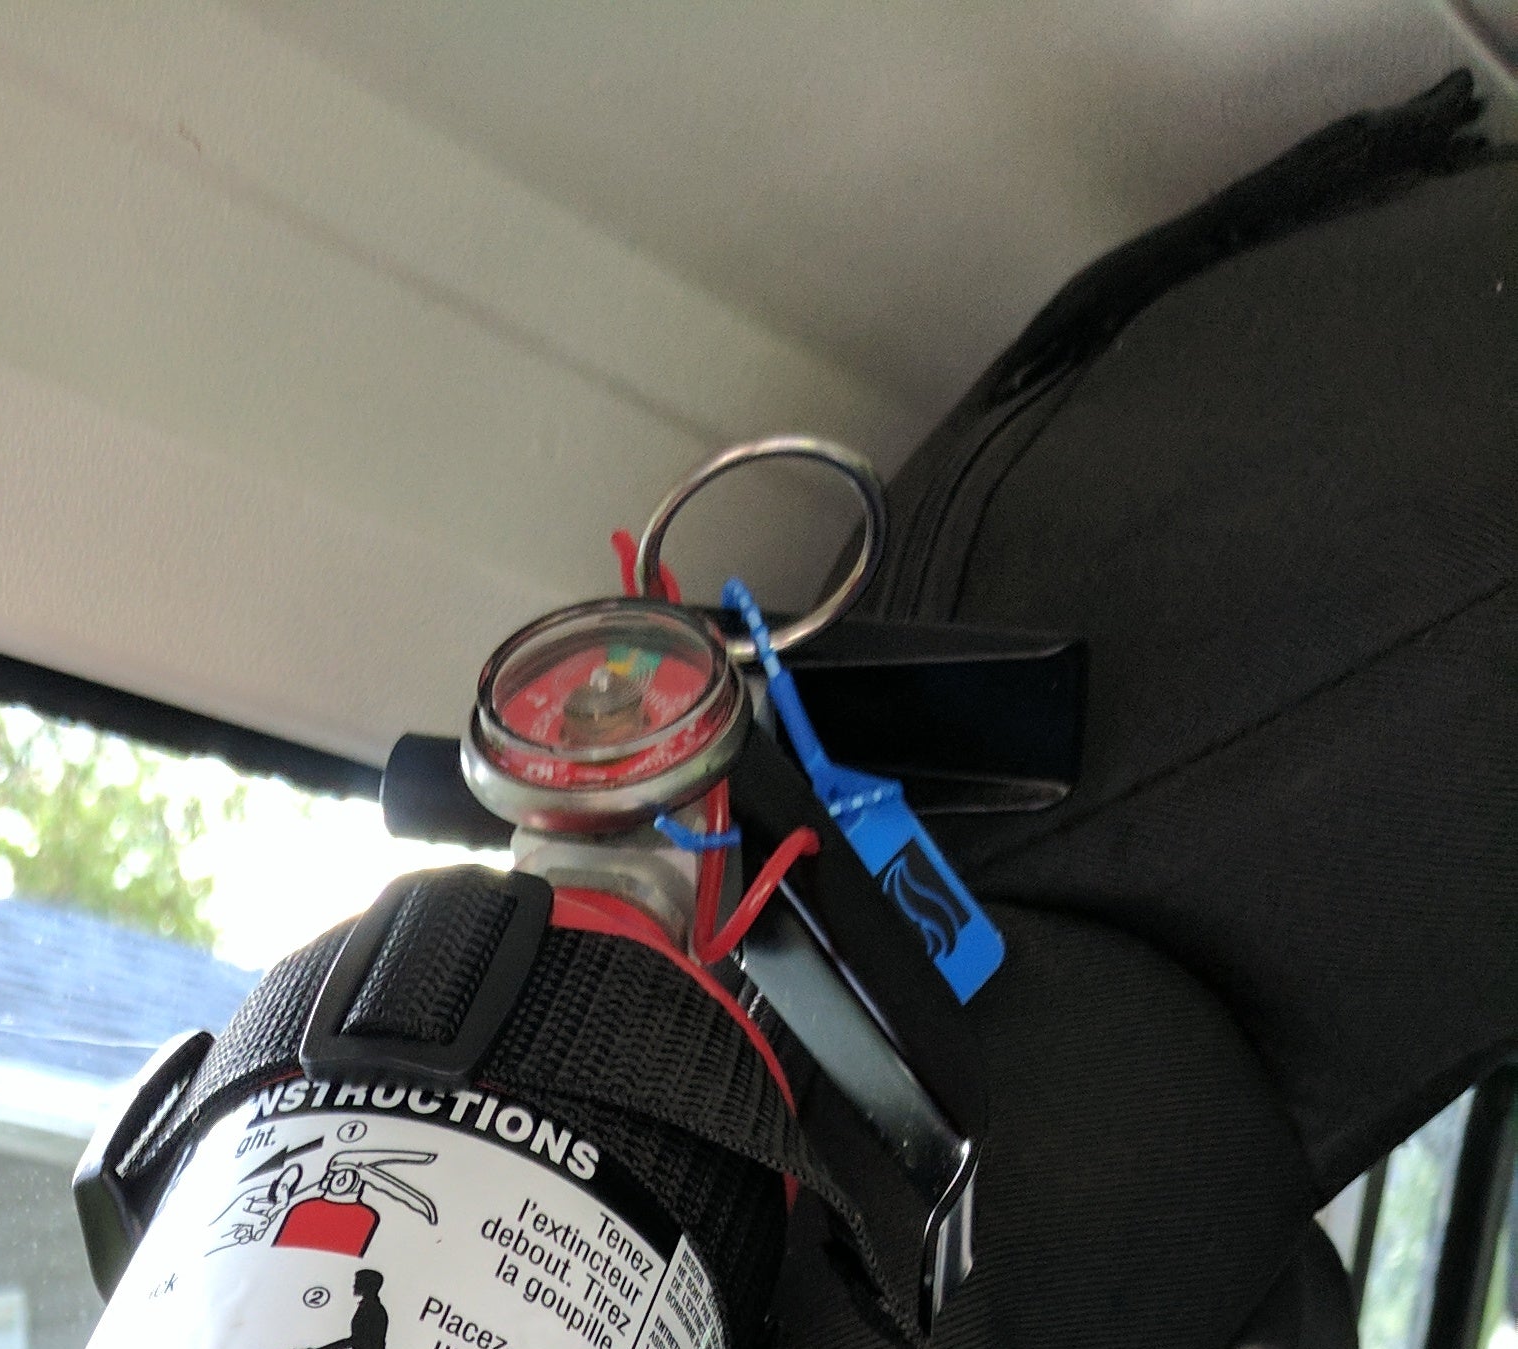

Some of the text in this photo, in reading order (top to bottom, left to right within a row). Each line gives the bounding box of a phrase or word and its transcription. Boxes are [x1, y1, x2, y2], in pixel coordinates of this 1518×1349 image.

[250, 1082, 602, 1181] NSTRUCTIONS
[481, 1217, 570, 1287] debout.
[583, 1272, 630, 1336] Tirez
[495, 1254, 518, 1286] la
[517, 1198, 642, 1306] l'extincteur
[597, 1211, 653, 1281] Tenez
